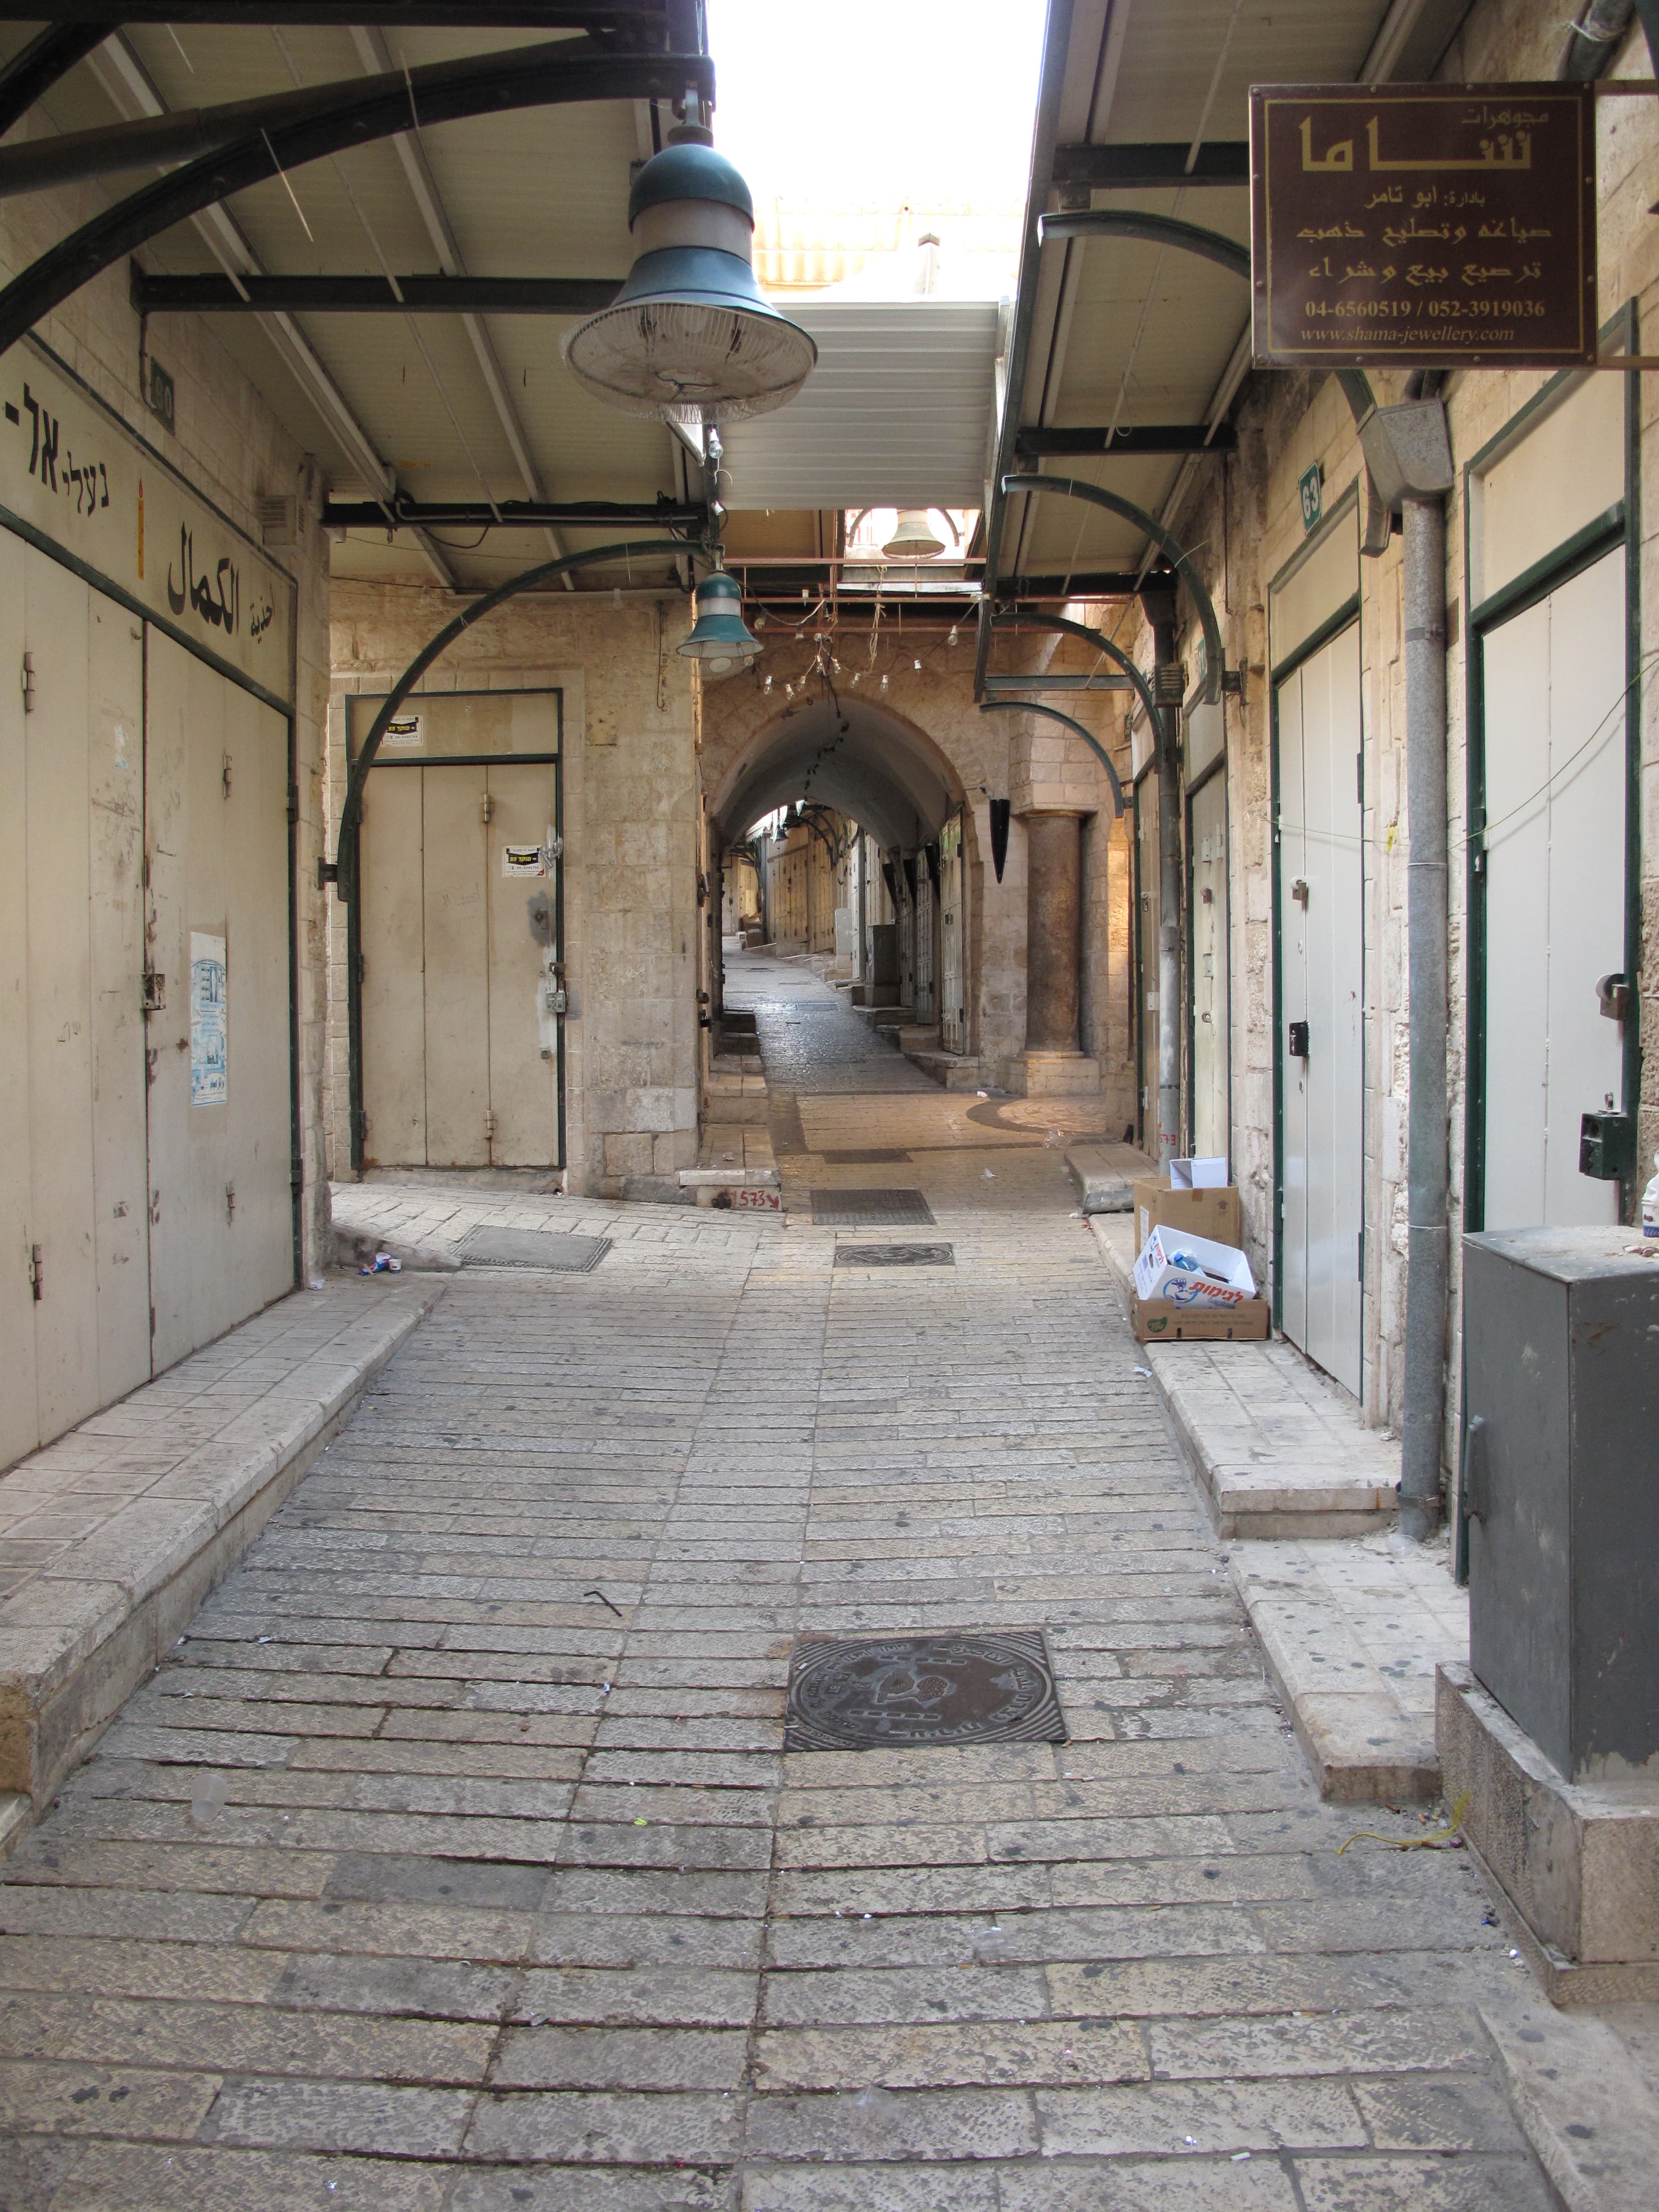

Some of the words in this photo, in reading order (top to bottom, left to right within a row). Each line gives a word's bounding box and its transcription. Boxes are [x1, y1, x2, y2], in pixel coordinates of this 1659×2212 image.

[1461, 105, 1548, 129] مجوهرات
[1363, 185, 1403, 208] تامر
[1411, 185, 1437, 208] ابو
[1296, 220, 1366, 243] ذهب
[1405, 261, 1449, 287] بيع
[1305, 300, 1412, 318] 04-6560519
[1428, 300, 1546, 318] 052-3919036
[1301, 326, 1515, 345] www.shama-jewellery.com
[62, 449, 110, 517] נעלי
[1302, 476, 1319, 520] 63
[168, 520, 239, 636] الكمال
[1189, 1281, 1244, 1303] לגימות
